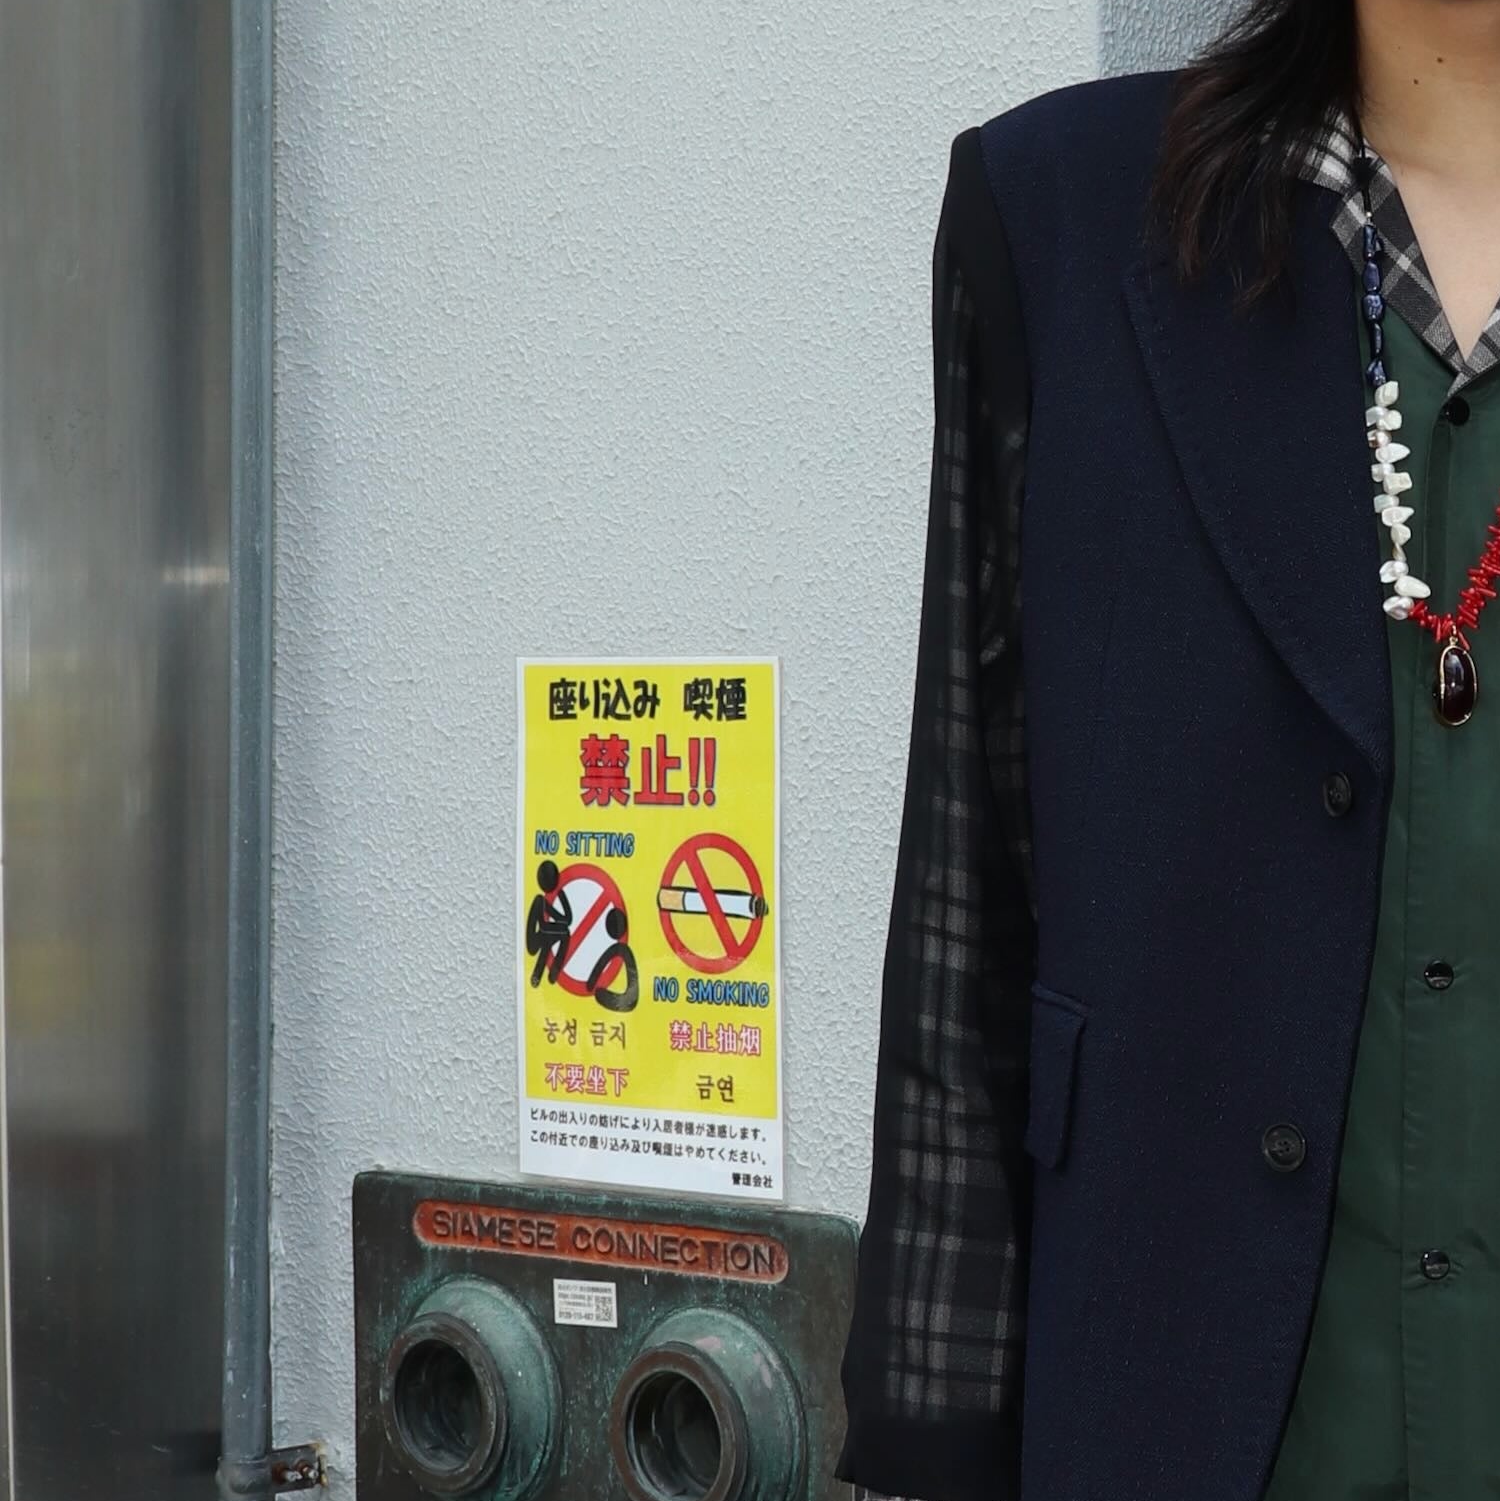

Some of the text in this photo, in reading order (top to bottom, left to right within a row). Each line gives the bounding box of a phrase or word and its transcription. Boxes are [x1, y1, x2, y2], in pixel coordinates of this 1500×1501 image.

[549, 677, 748, 722] 座り込み 喫煙
[580, 734, 717, 807] 禁止!!
[535, 830, 635, 858] NO SITTING
[653, 977, 770, 1008] NO SMOKING
[543, 1018, 626, 1049] 농성 금지
[670, 1020, 761, 1057] 禁止抽烟
[545, 1062, 630, 1097] 不要坐下
[696, 1075, 735, 1103] 금연
[732, 1172, 773, 1189] 管理会社
[432, 1210, 780, 1274] SIAMESE CONNECTION
